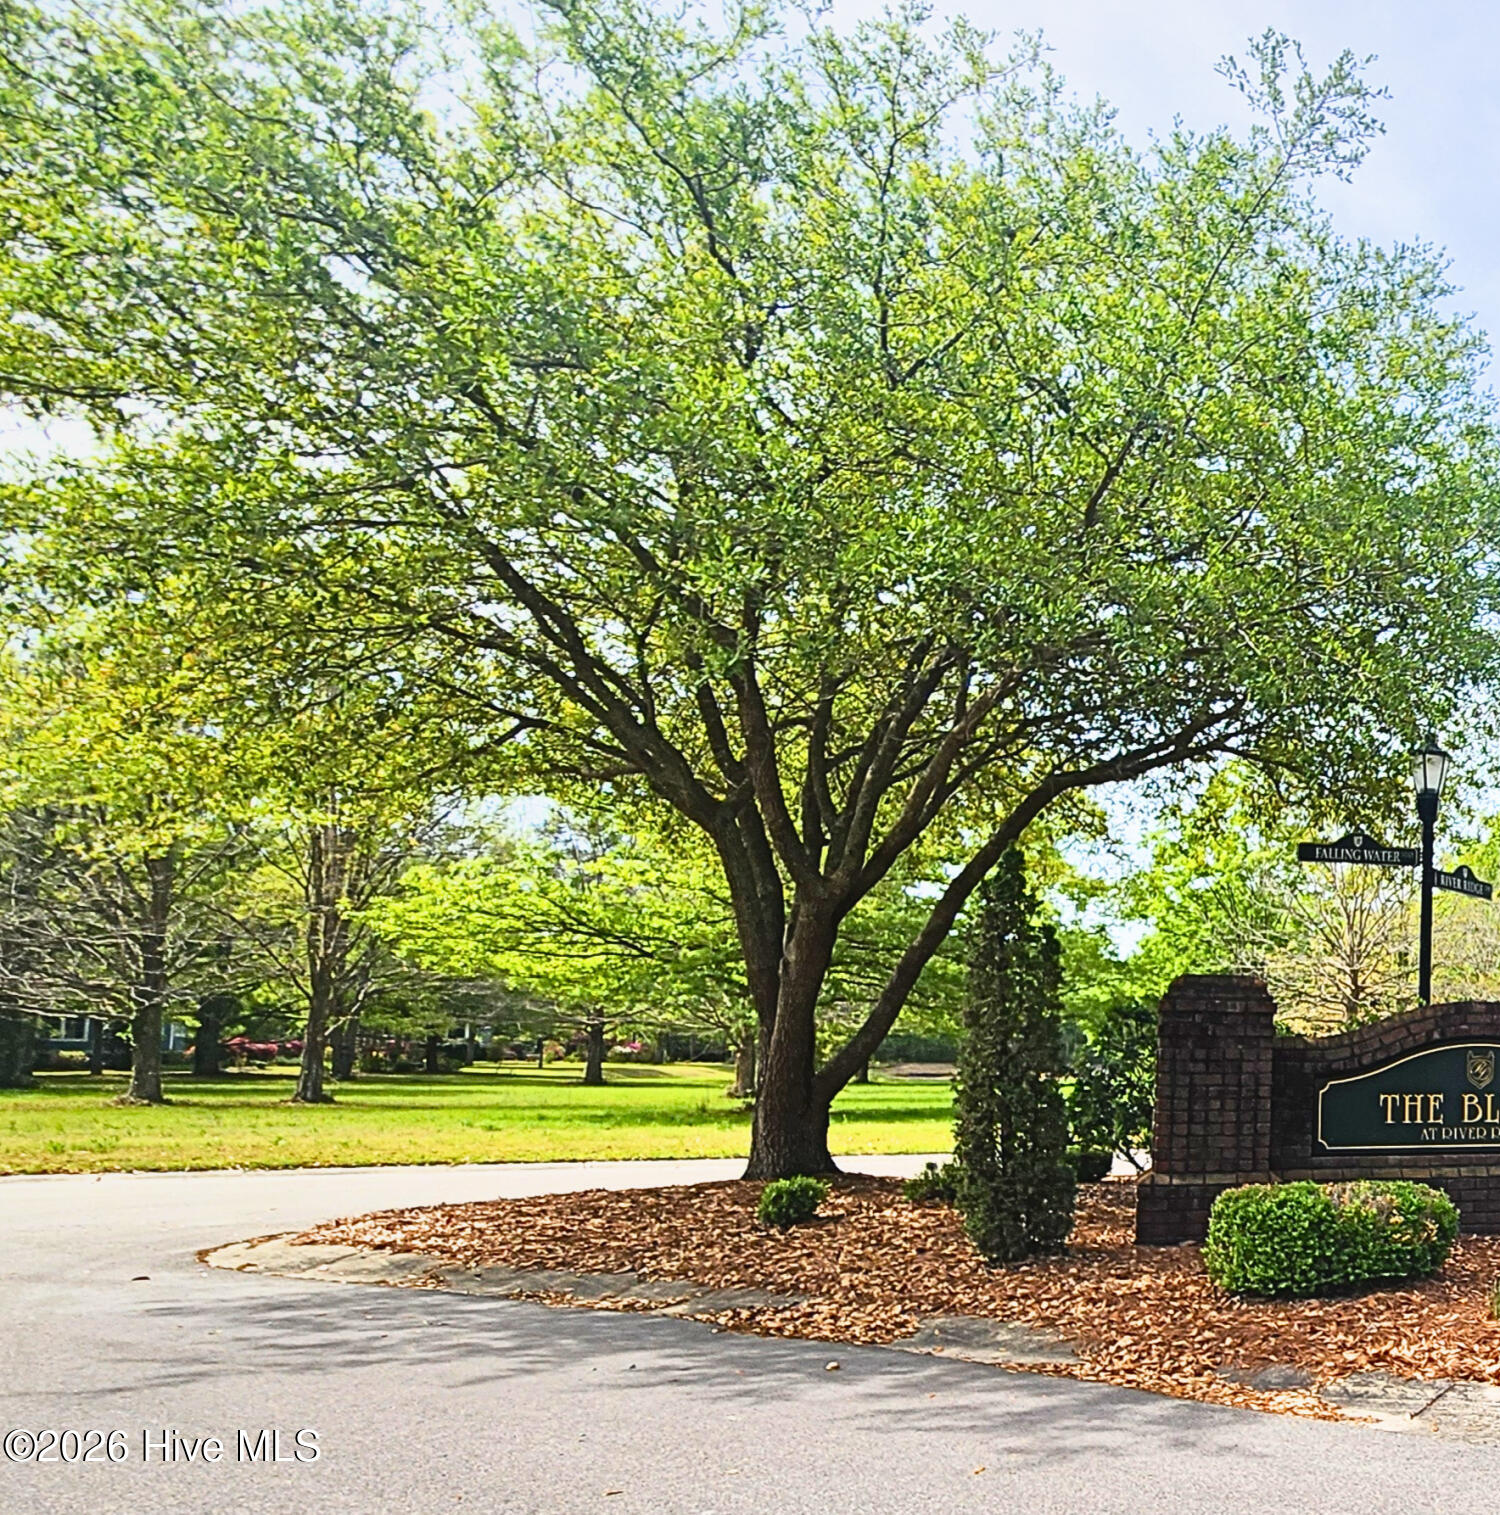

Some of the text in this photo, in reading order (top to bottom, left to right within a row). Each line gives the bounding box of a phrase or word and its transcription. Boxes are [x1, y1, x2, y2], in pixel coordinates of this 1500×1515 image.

[1315, 847, 1362, 861] FALLING
[1363, 849, 1400, 863] WATER
[1440, 874, 1461, 890] RIVER
[1379, 1092, 1444, 1124] THE
[1420, 1127, 1438, 1141] AT
[1443, 1127, 1488, 1140] RIVER
